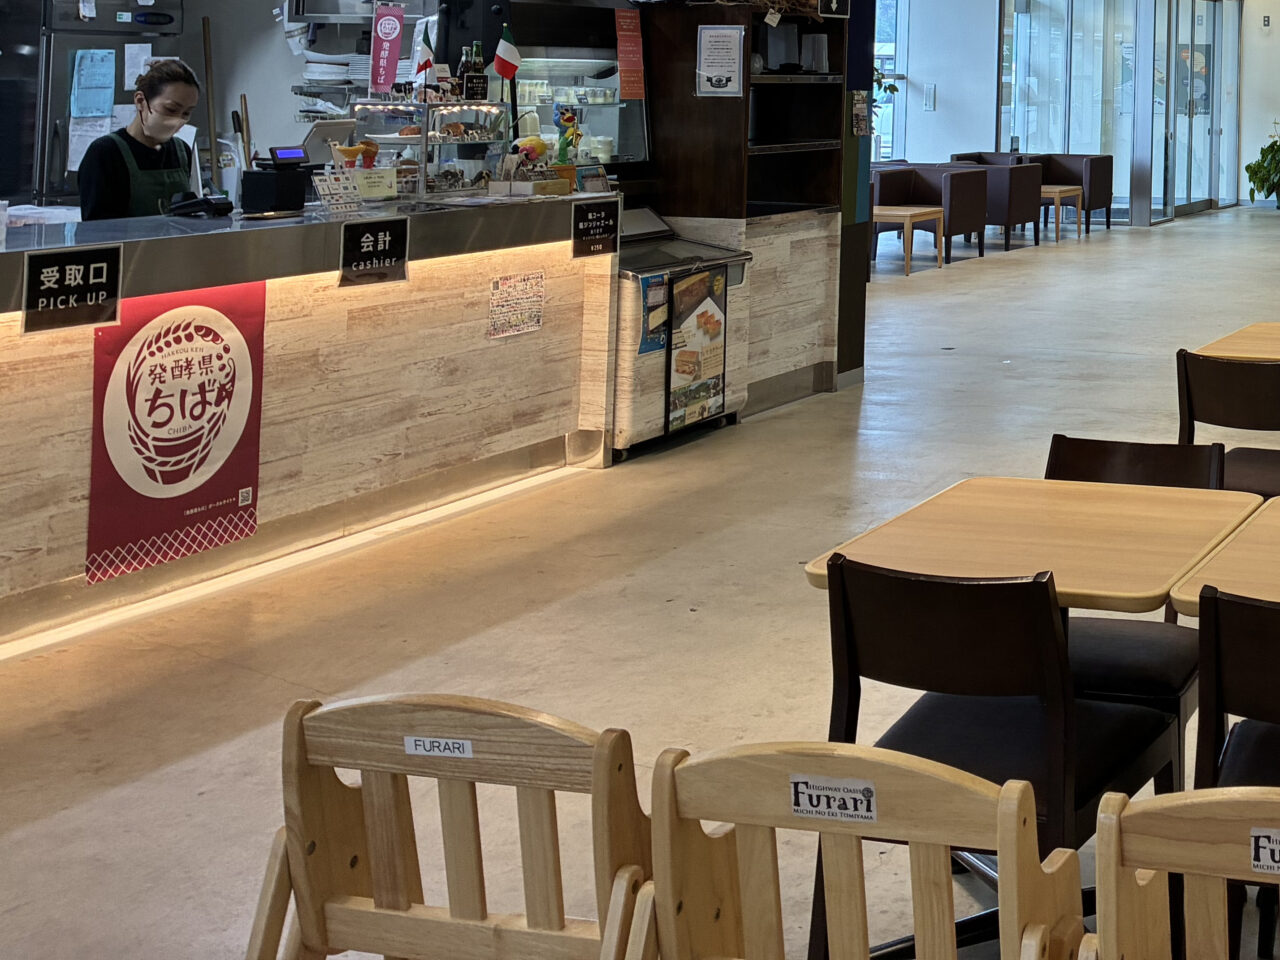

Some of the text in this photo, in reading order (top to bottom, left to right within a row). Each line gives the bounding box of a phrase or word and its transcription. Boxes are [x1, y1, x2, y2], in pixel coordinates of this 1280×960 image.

[360, 231, 392, 252] 会計
[351, 256, 397, 272] cashier
[39, 261, 108, 291] 受取口
[38, 291, 108, 312] PICK UP
[148, 353, 214, 386] 発酵県
[144, 379, 217, 429] ちば
[167, 424, 193, 436] CHIBA
[413, 739, 466, 755] FURARI
[790, 781, 873, 813] Furari
